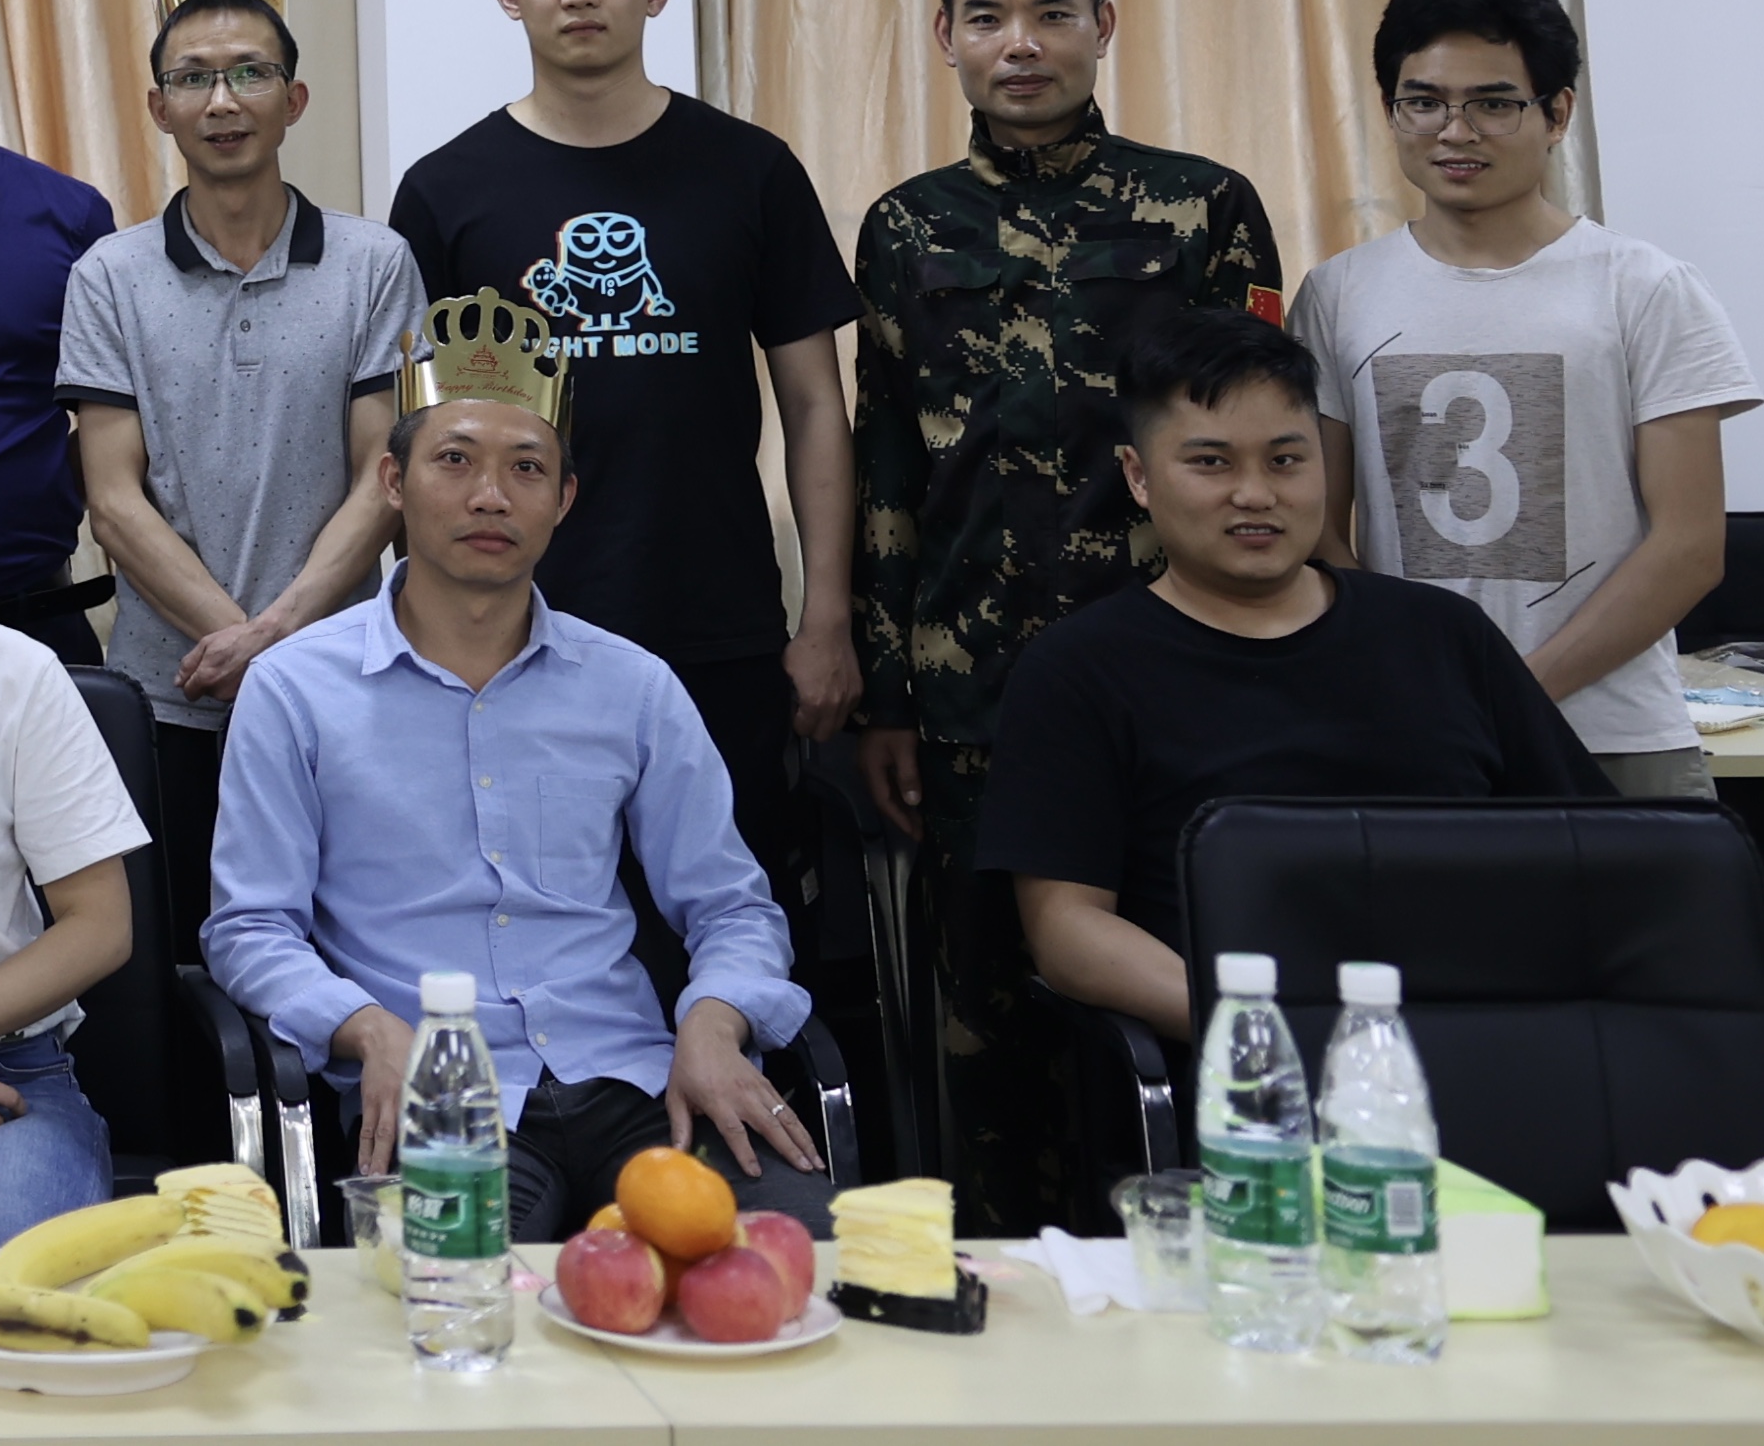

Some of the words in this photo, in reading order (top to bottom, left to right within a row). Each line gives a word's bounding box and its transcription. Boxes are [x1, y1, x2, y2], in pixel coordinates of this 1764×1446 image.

[524, 334, 604, 359] GHT
[612, 332, 700, 355] MODE
[435, 381, 474, 394] Happy
[478, 381, 534, 402] Birthday
[1419, 370, 1520, 546] 3
